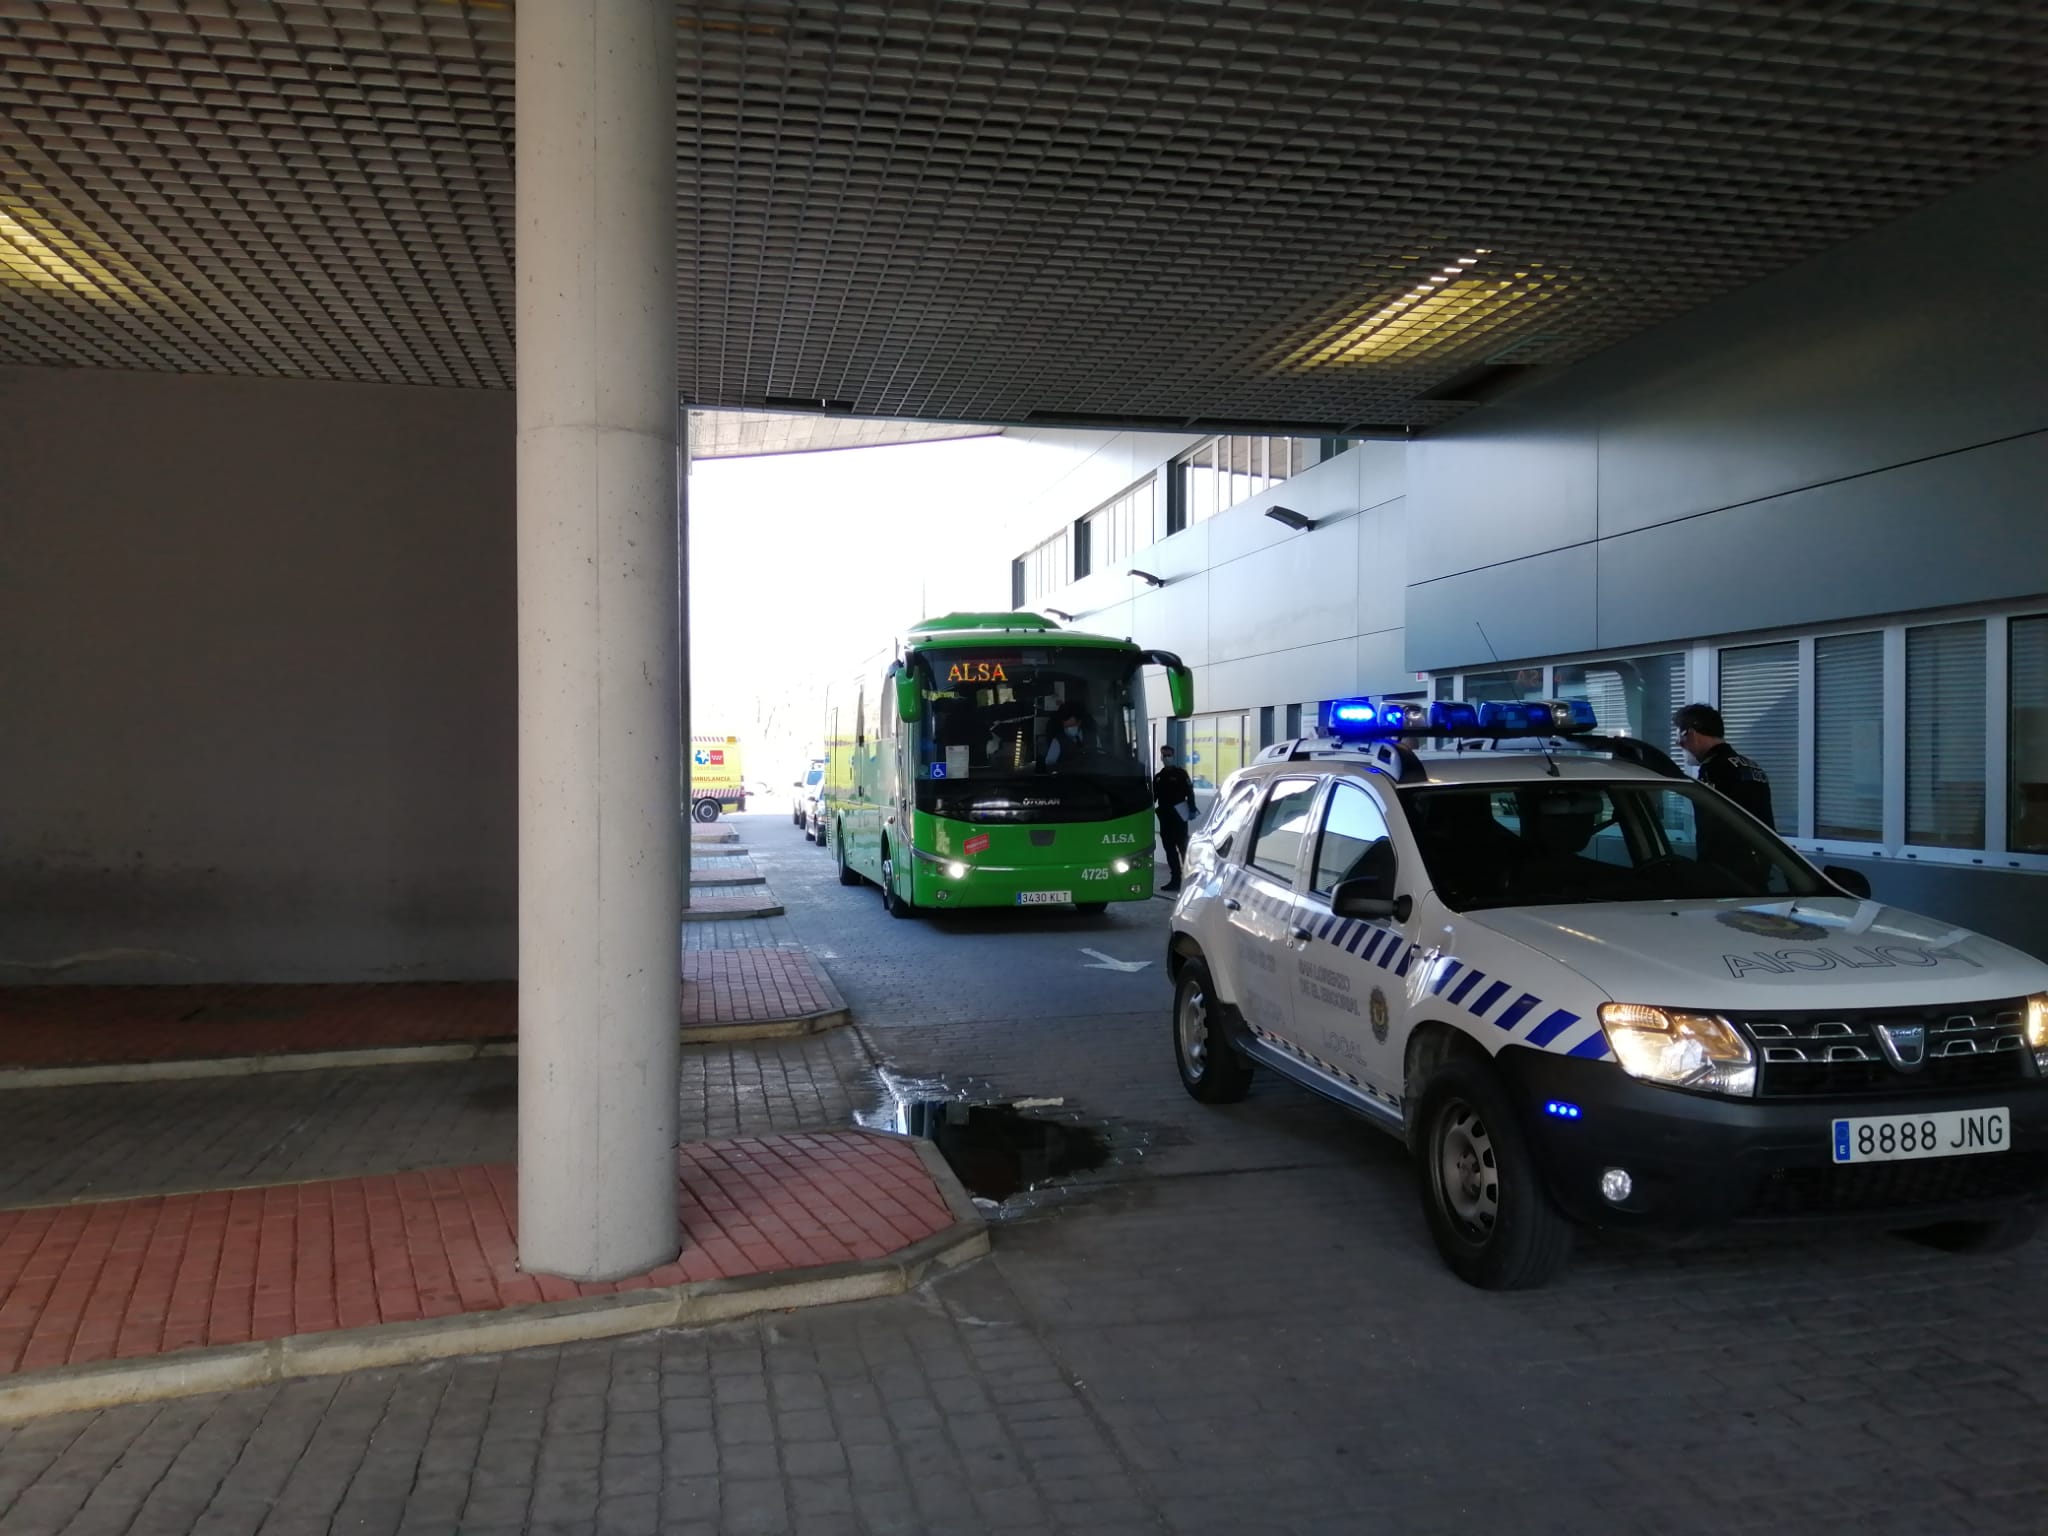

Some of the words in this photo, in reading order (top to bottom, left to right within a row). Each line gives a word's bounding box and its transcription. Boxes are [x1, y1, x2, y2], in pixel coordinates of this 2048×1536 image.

[948, 663, 1008, 682] ALSA
[1102, 833, 1136, 844] ALSA
[1081, 868, 1109, 880] 4725
[1022, 893, 1047, 903] 3430
[1858, 1120, 1937, 1155] 8888
[1950, 1115, 2003, 1148] JNG
